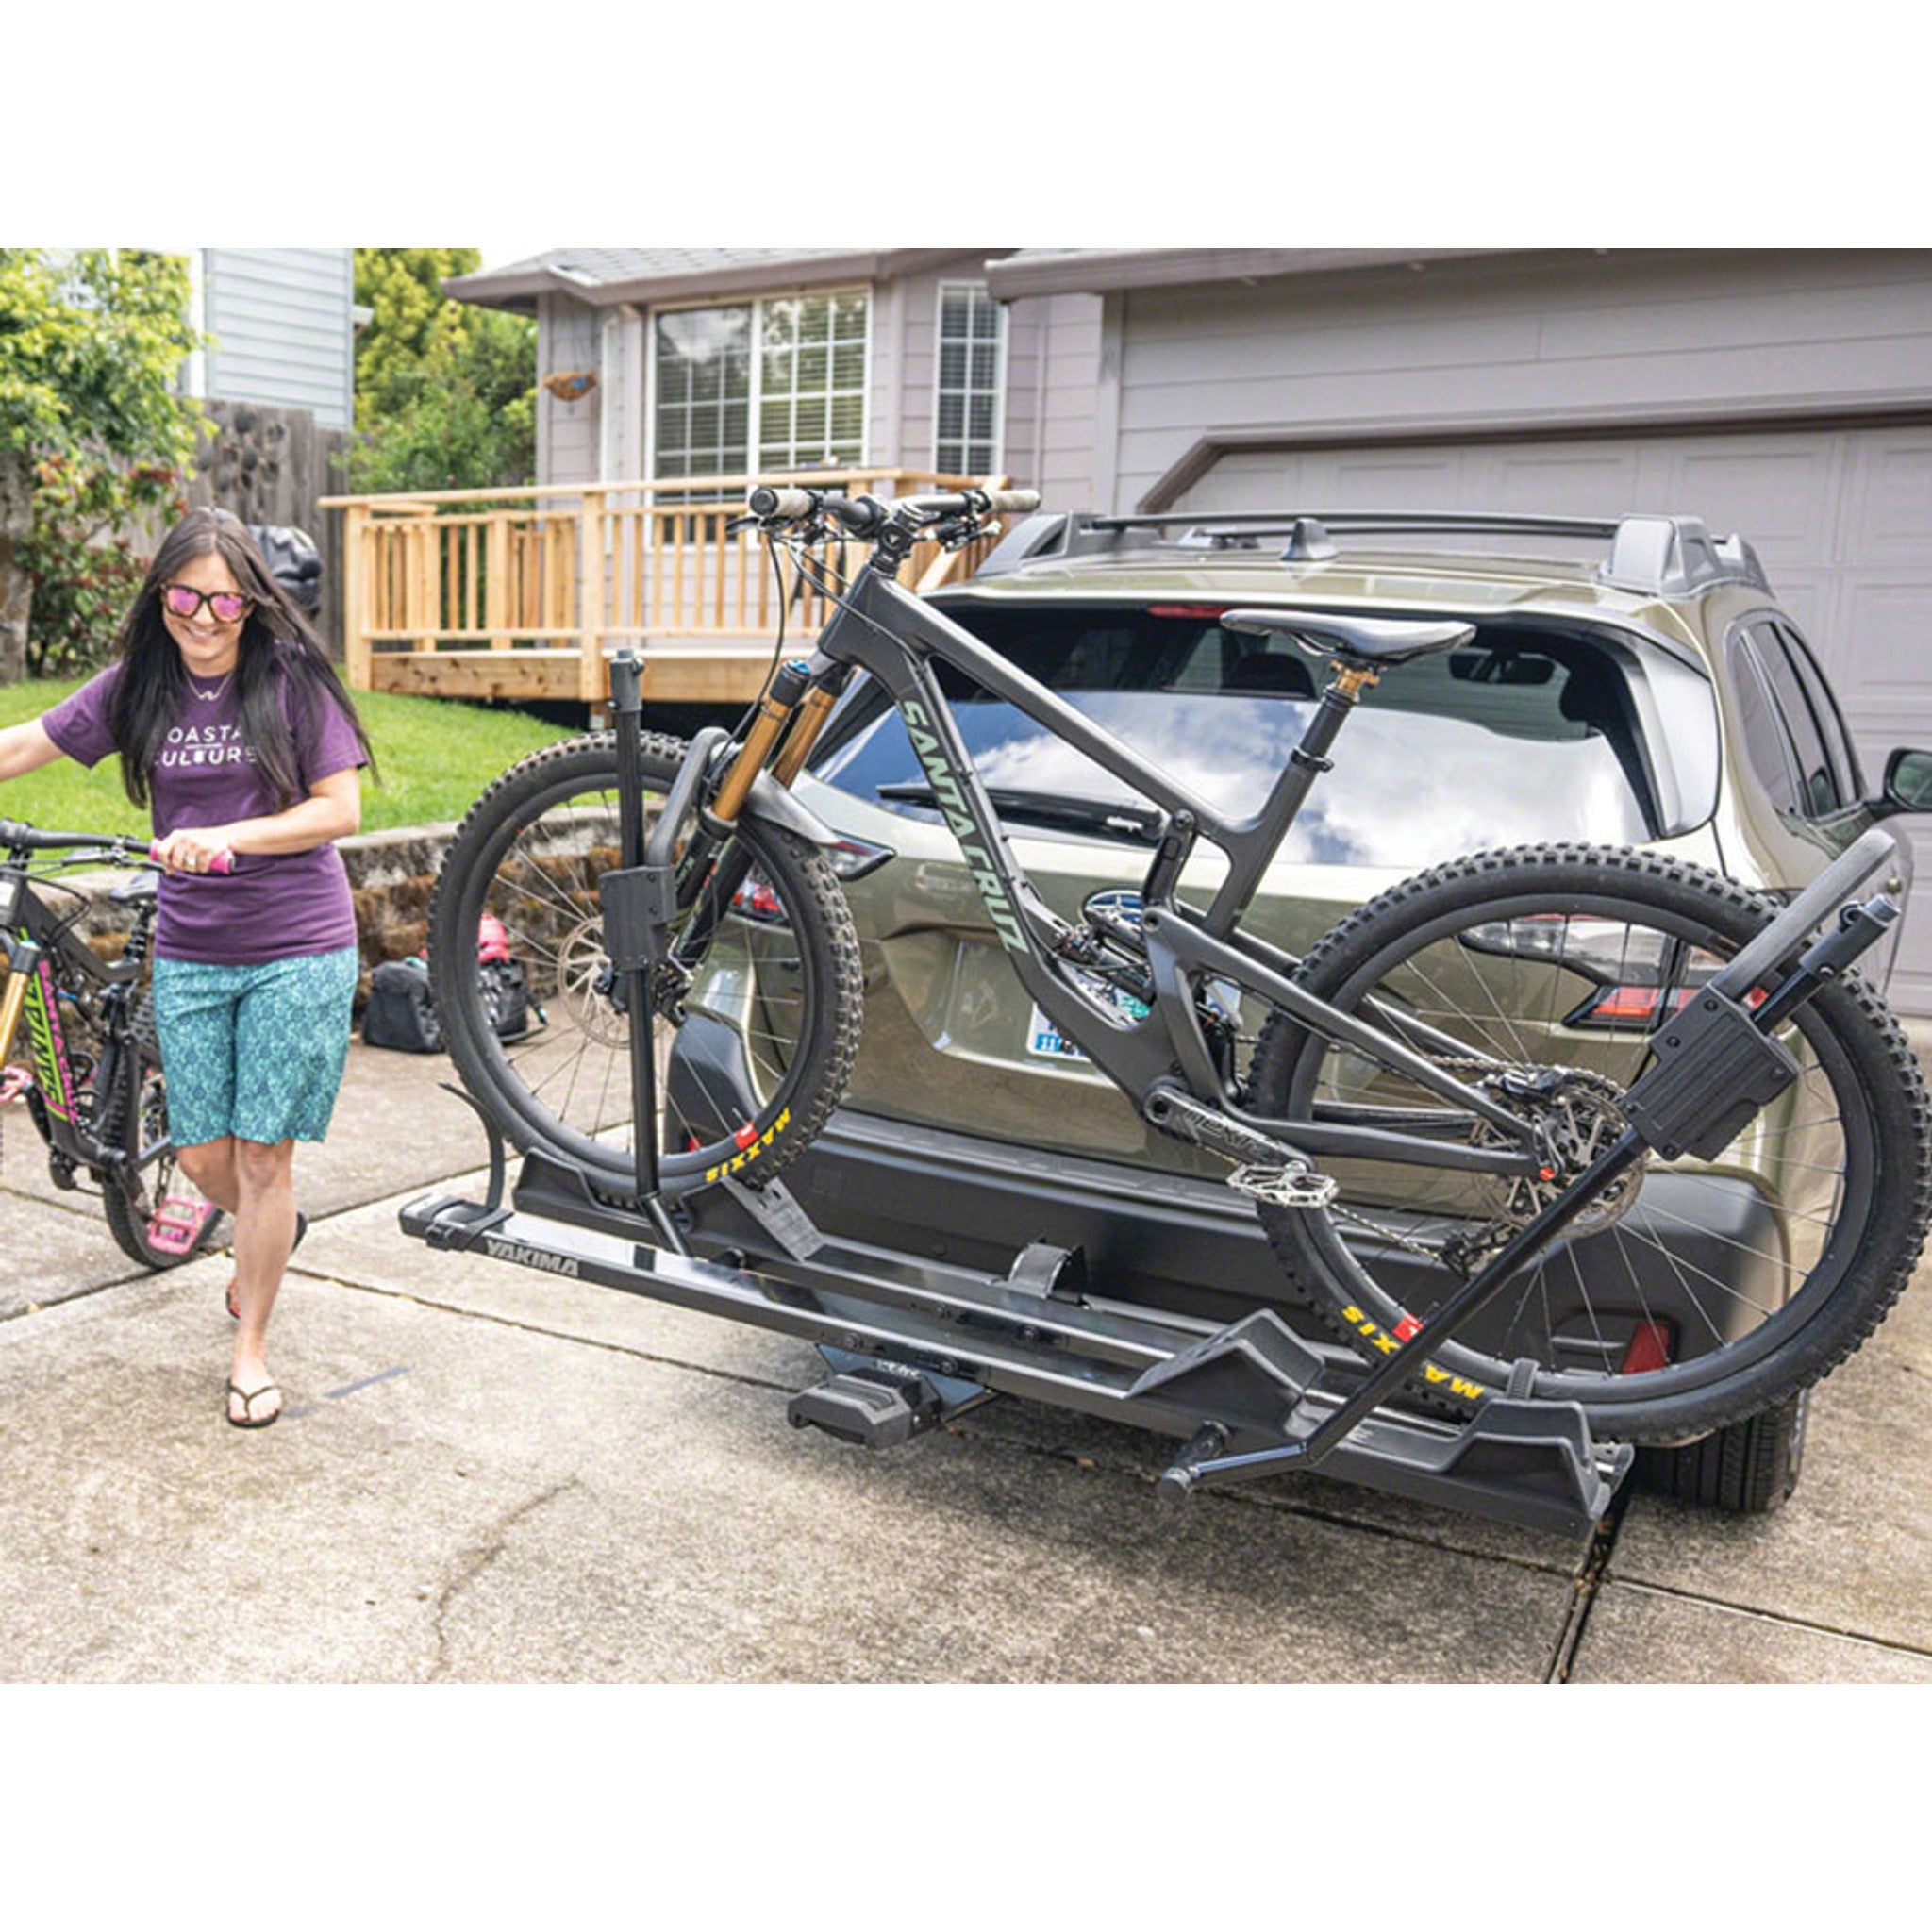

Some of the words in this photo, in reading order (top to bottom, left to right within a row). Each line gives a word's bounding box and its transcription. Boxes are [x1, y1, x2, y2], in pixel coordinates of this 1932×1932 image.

[901, 700, 975, 839] SANTA
[963, 845, 1029, 955] CRUZ
[705, 1107, 791, 1183] MAXXIS
[487, 1241, 578, 1277] YAKIMA
[1342, 1305, 1484, 1399] MAXIS
